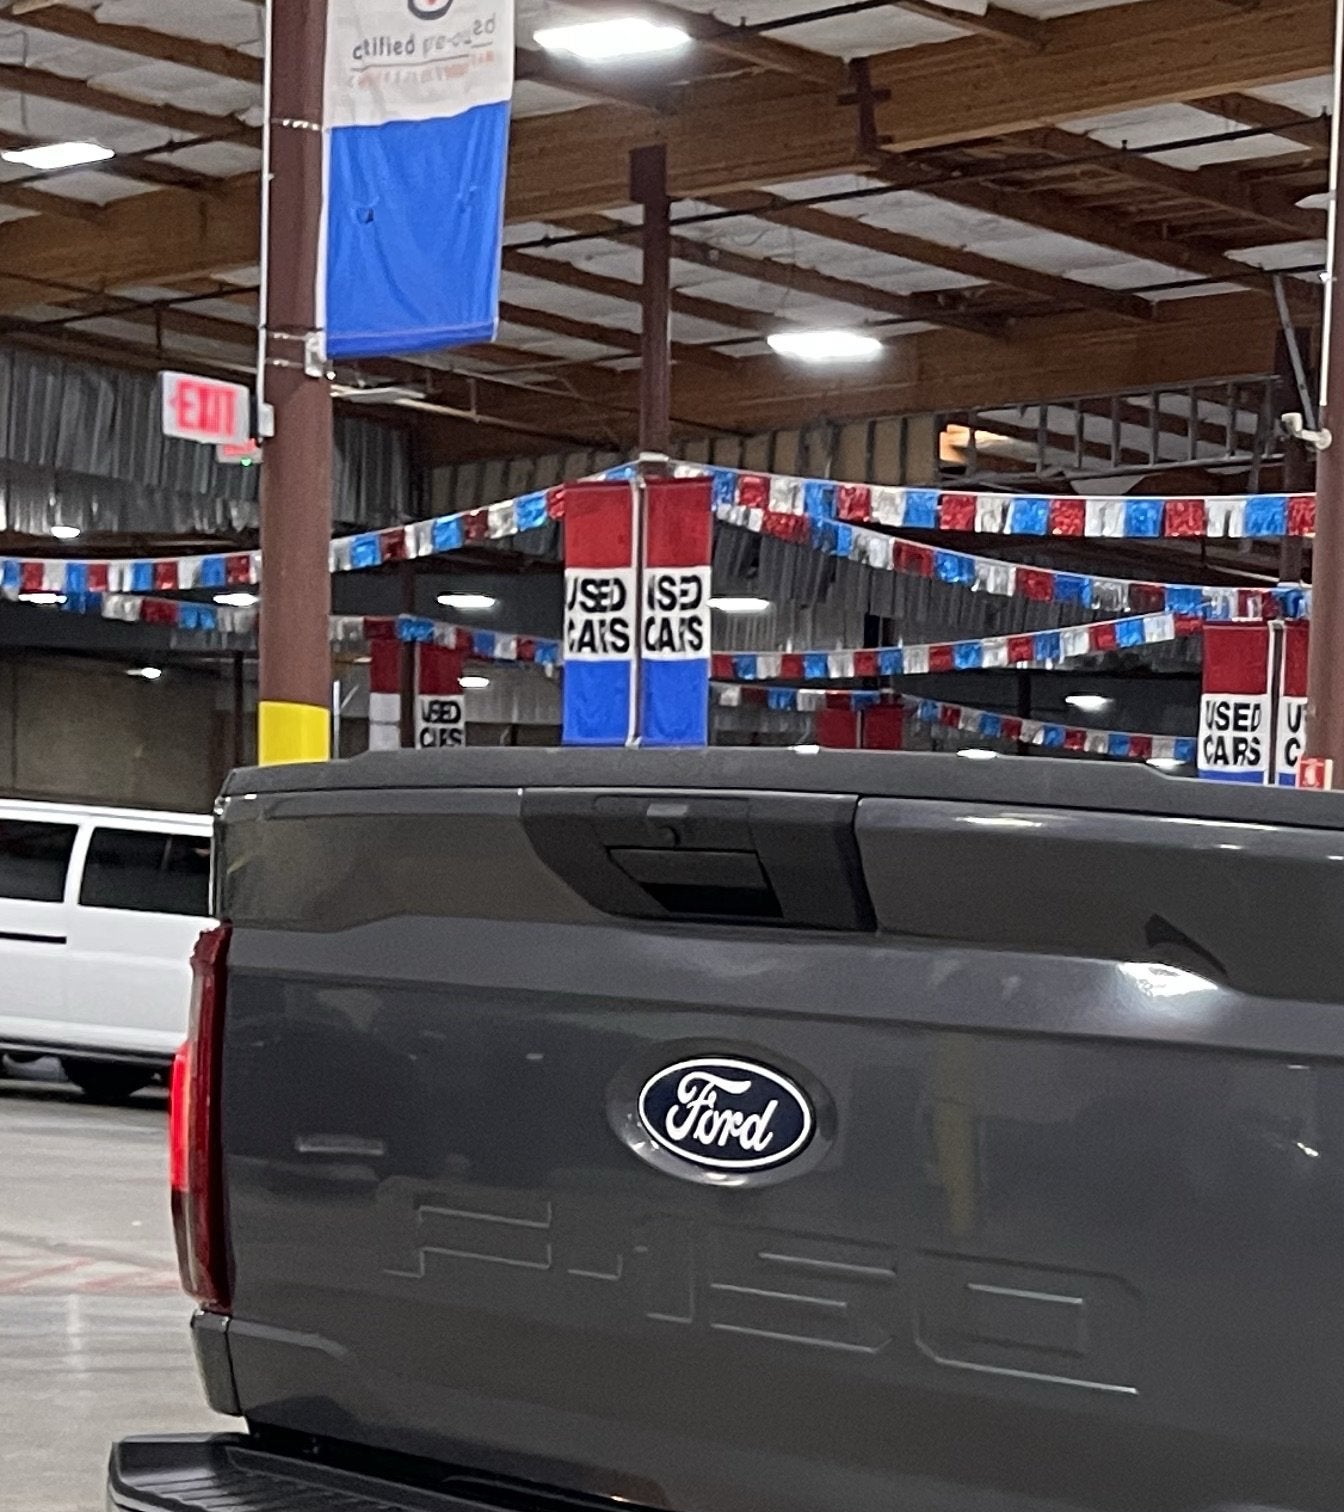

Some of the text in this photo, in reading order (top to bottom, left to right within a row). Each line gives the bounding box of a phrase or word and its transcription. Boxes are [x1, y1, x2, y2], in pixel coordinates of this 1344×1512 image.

[176, 379, 236, 437] EXIT
[1205, 700, 1262, 732] USED
[1203, 735, 1262, 766] CARS
[665, 1071, 778, 1152] Ford
